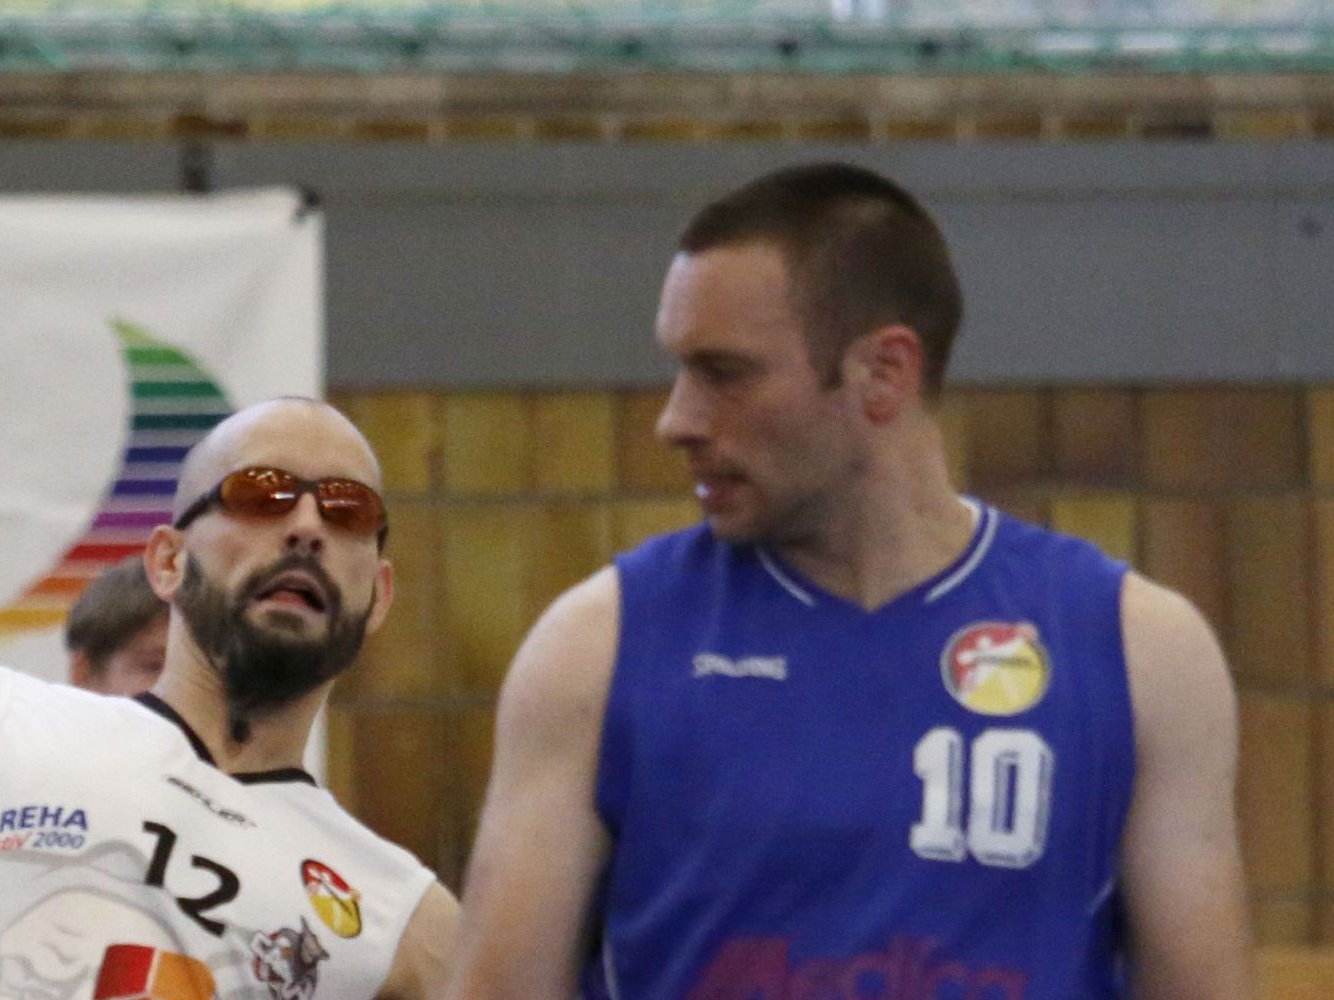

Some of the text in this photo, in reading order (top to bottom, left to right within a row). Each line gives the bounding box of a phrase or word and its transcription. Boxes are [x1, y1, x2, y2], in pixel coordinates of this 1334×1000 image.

[33, 831, 85, 849] 2000
[908, 725, 1056, 869] 10
[141, 820, 241, 938] 12
